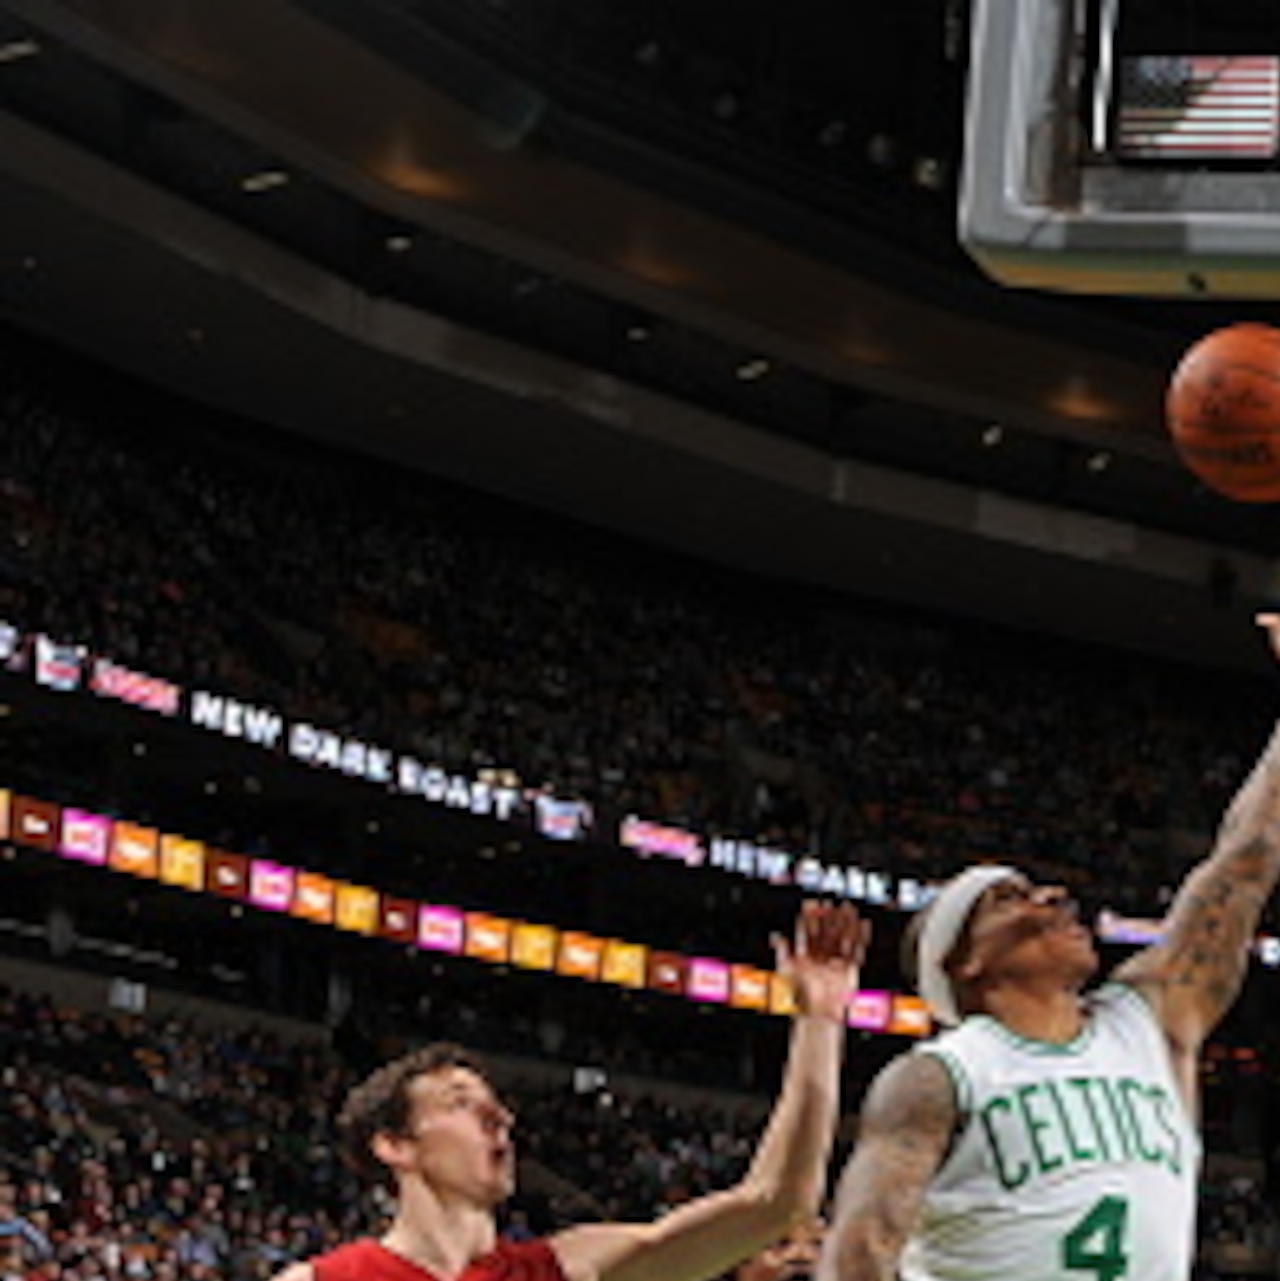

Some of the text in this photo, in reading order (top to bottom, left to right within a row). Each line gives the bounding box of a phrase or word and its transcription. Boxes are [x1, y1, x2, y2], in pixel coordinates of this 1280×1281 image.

[192, 691, 518, 820] NEW DARK ROAST
[711, 837, 790, 881] NEW
[980, 1077, 1183, 1190] CELTICS
